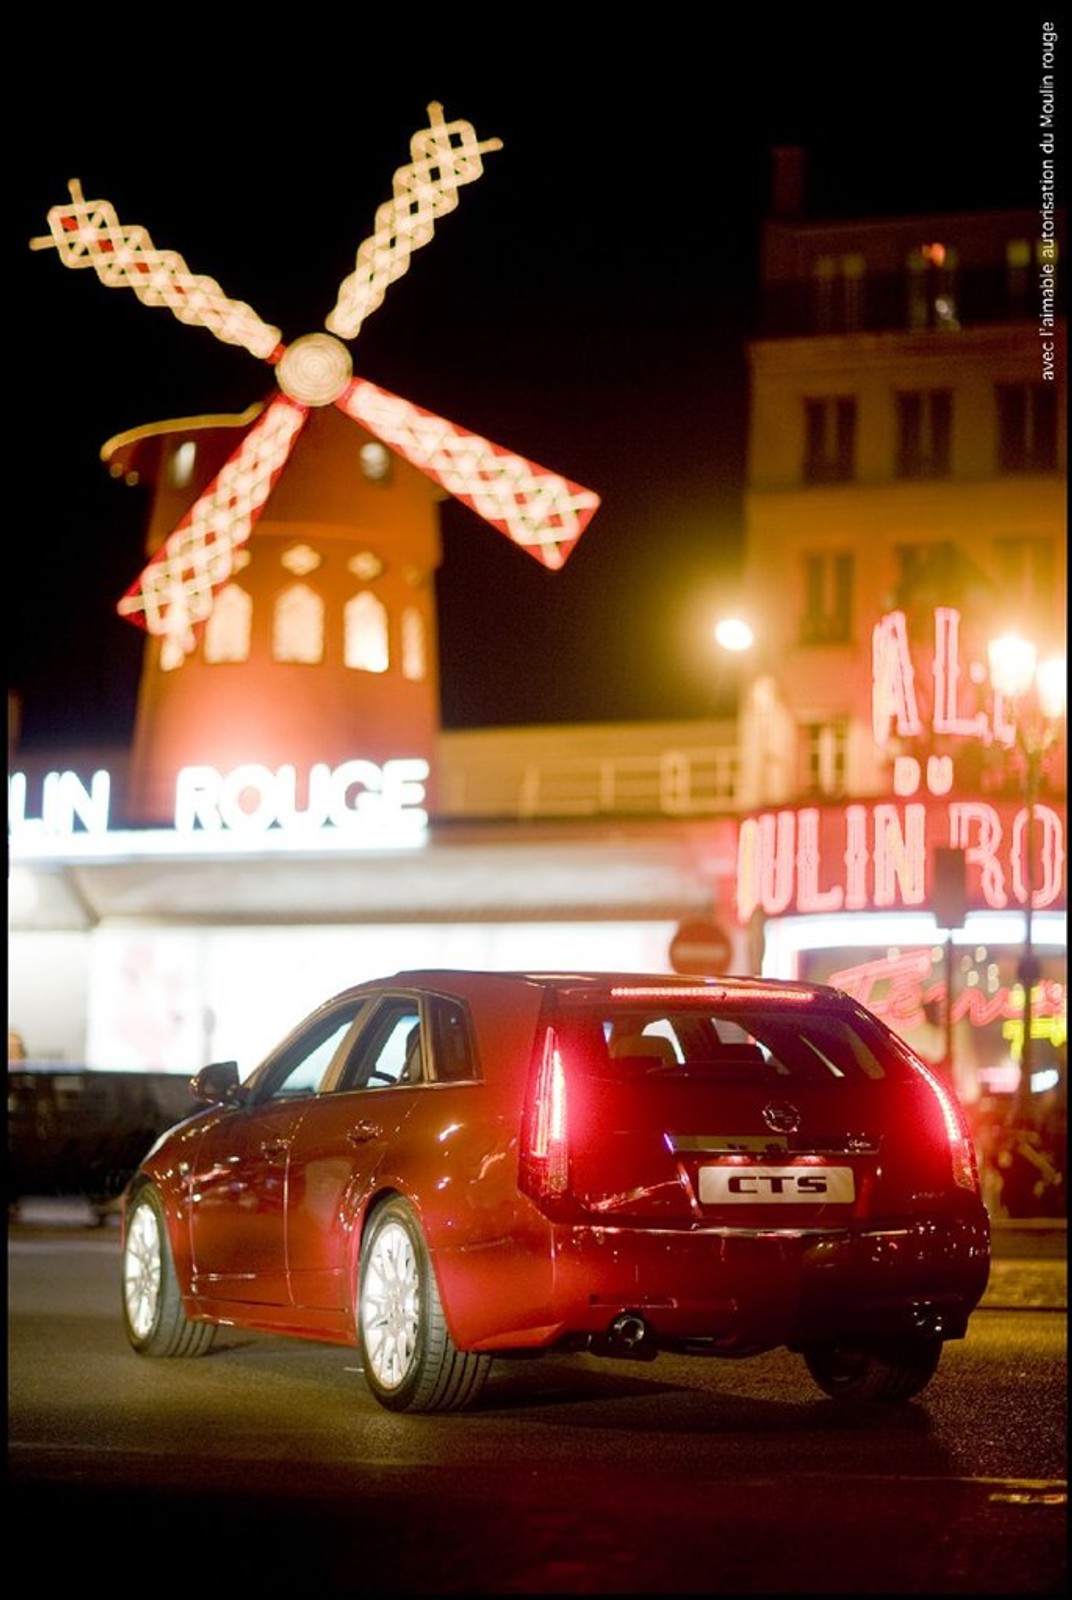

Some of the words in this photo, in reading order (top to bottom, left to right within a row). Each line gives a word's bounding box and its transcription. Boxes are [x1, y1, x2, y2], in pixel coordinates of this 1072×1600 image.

[175, 758, 431, 835] ROUGE
[893, 755, 954, 797] DU
[949, 802, 1064, 909] RO
[727, 1176, 828, 1194] CTS
